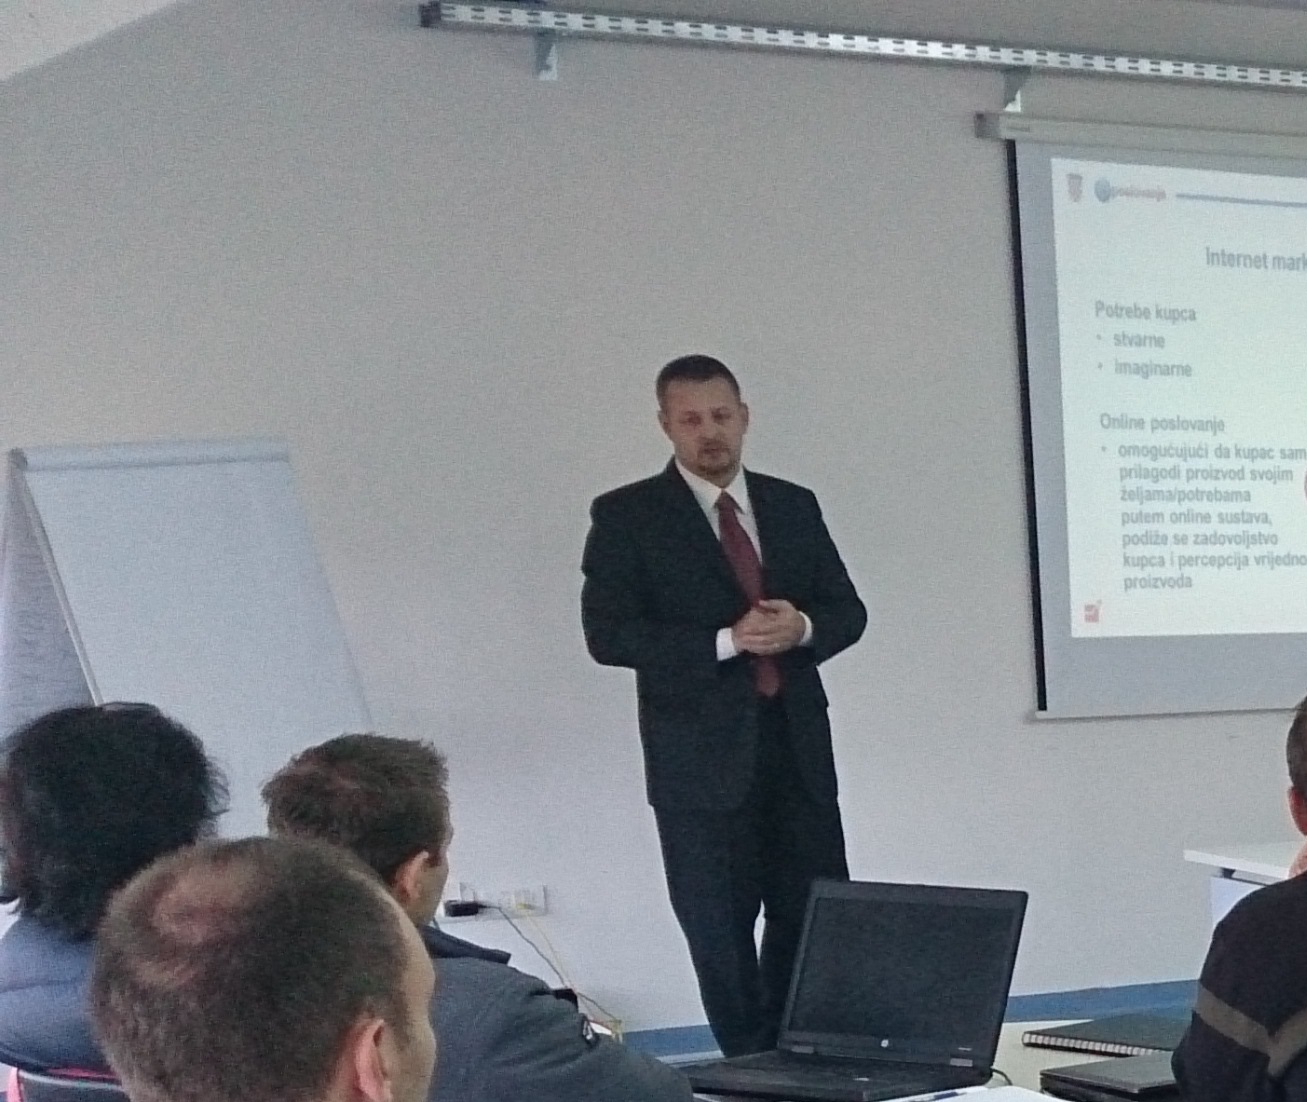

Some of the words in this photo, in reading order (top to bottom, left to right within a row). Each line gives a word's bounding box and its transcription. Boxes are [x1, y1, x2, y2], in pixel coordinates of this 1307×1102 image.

[1205, 247, 1268, 270] Internet
[1095, 300, 1151, 321] Potrebe
[1155, 303, 1197, 324] kupca
[1114, 332, 1166, 349] stvarne
[1115, 359, 1192, 380] imaginarne
[1100, 412, 1146, 431] Online
[1150, 415, 1225, 436] poslovanje
[1214, 444, 1231, 460] da
[1234, 444, 1276, 463] kupac
[1279, 447, 1307, 460] sam
[1120, 463, 1181, 485] prilagodi
[1186, 465, 1244, 484] proizvod
[1249, 466, 1294, 486] svojim
[1121, 509, 1165, 527] putem
[1169, 508, 1212, 524] online
[1217, 509, 1273, 526] sustava,
[1122, 530, 1168, 549] podiže
[1172, 534, 1189, 546] se
[1192, 530, 1279, 549] zadovoljstvo
[1123, 552, 1166, 570] kupca
[1170, 552, 1175, 567] i
[1177, 552, 1249, 571] percepcija
[1124, 573, 1193, 592] proizvoda
